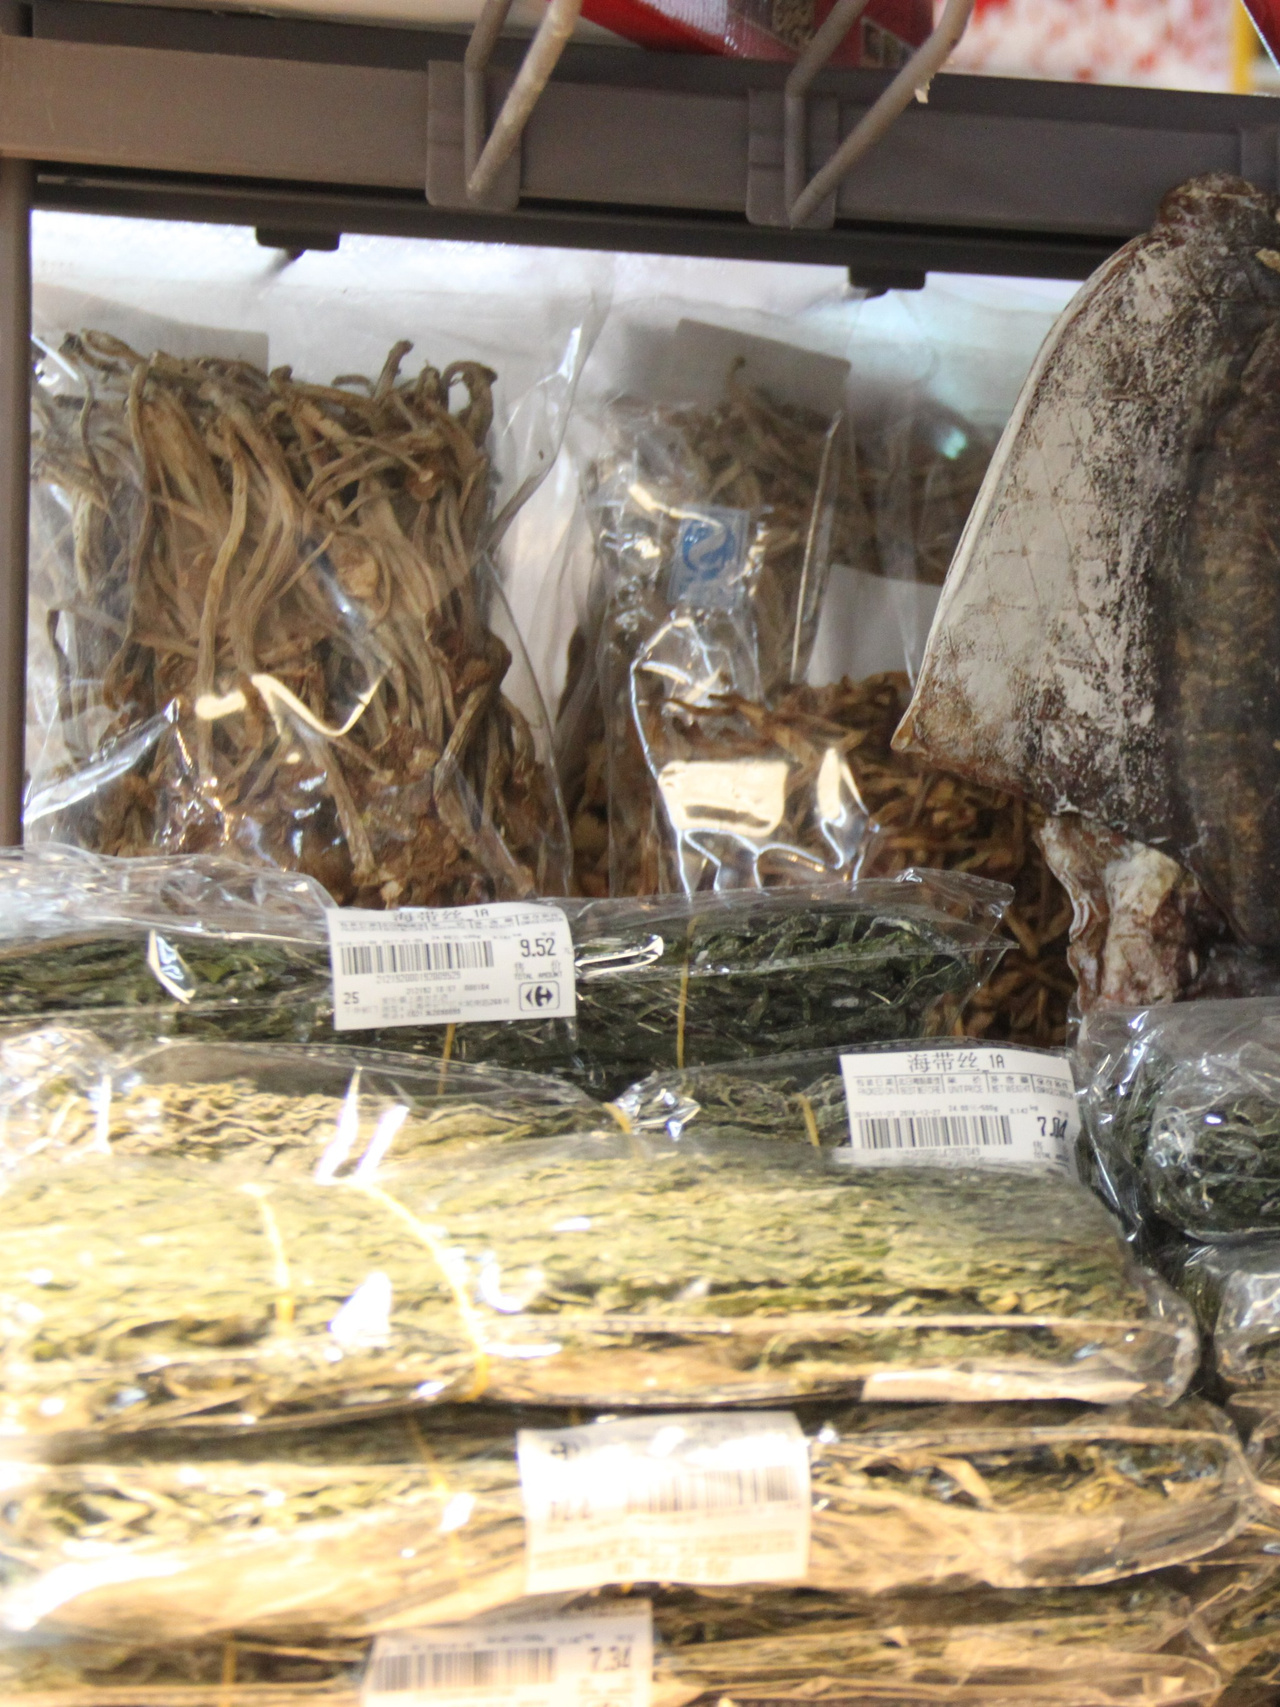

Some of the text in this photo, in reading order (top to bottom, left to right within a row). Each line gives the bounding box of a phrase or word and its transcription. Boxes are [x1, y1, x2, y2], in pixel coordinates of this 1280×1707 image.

[519, 937, 557, 958] 9.52
[343, 991, 360, 1005] 25
[907, 1052, 1006, 1073] 海带丝 1A
